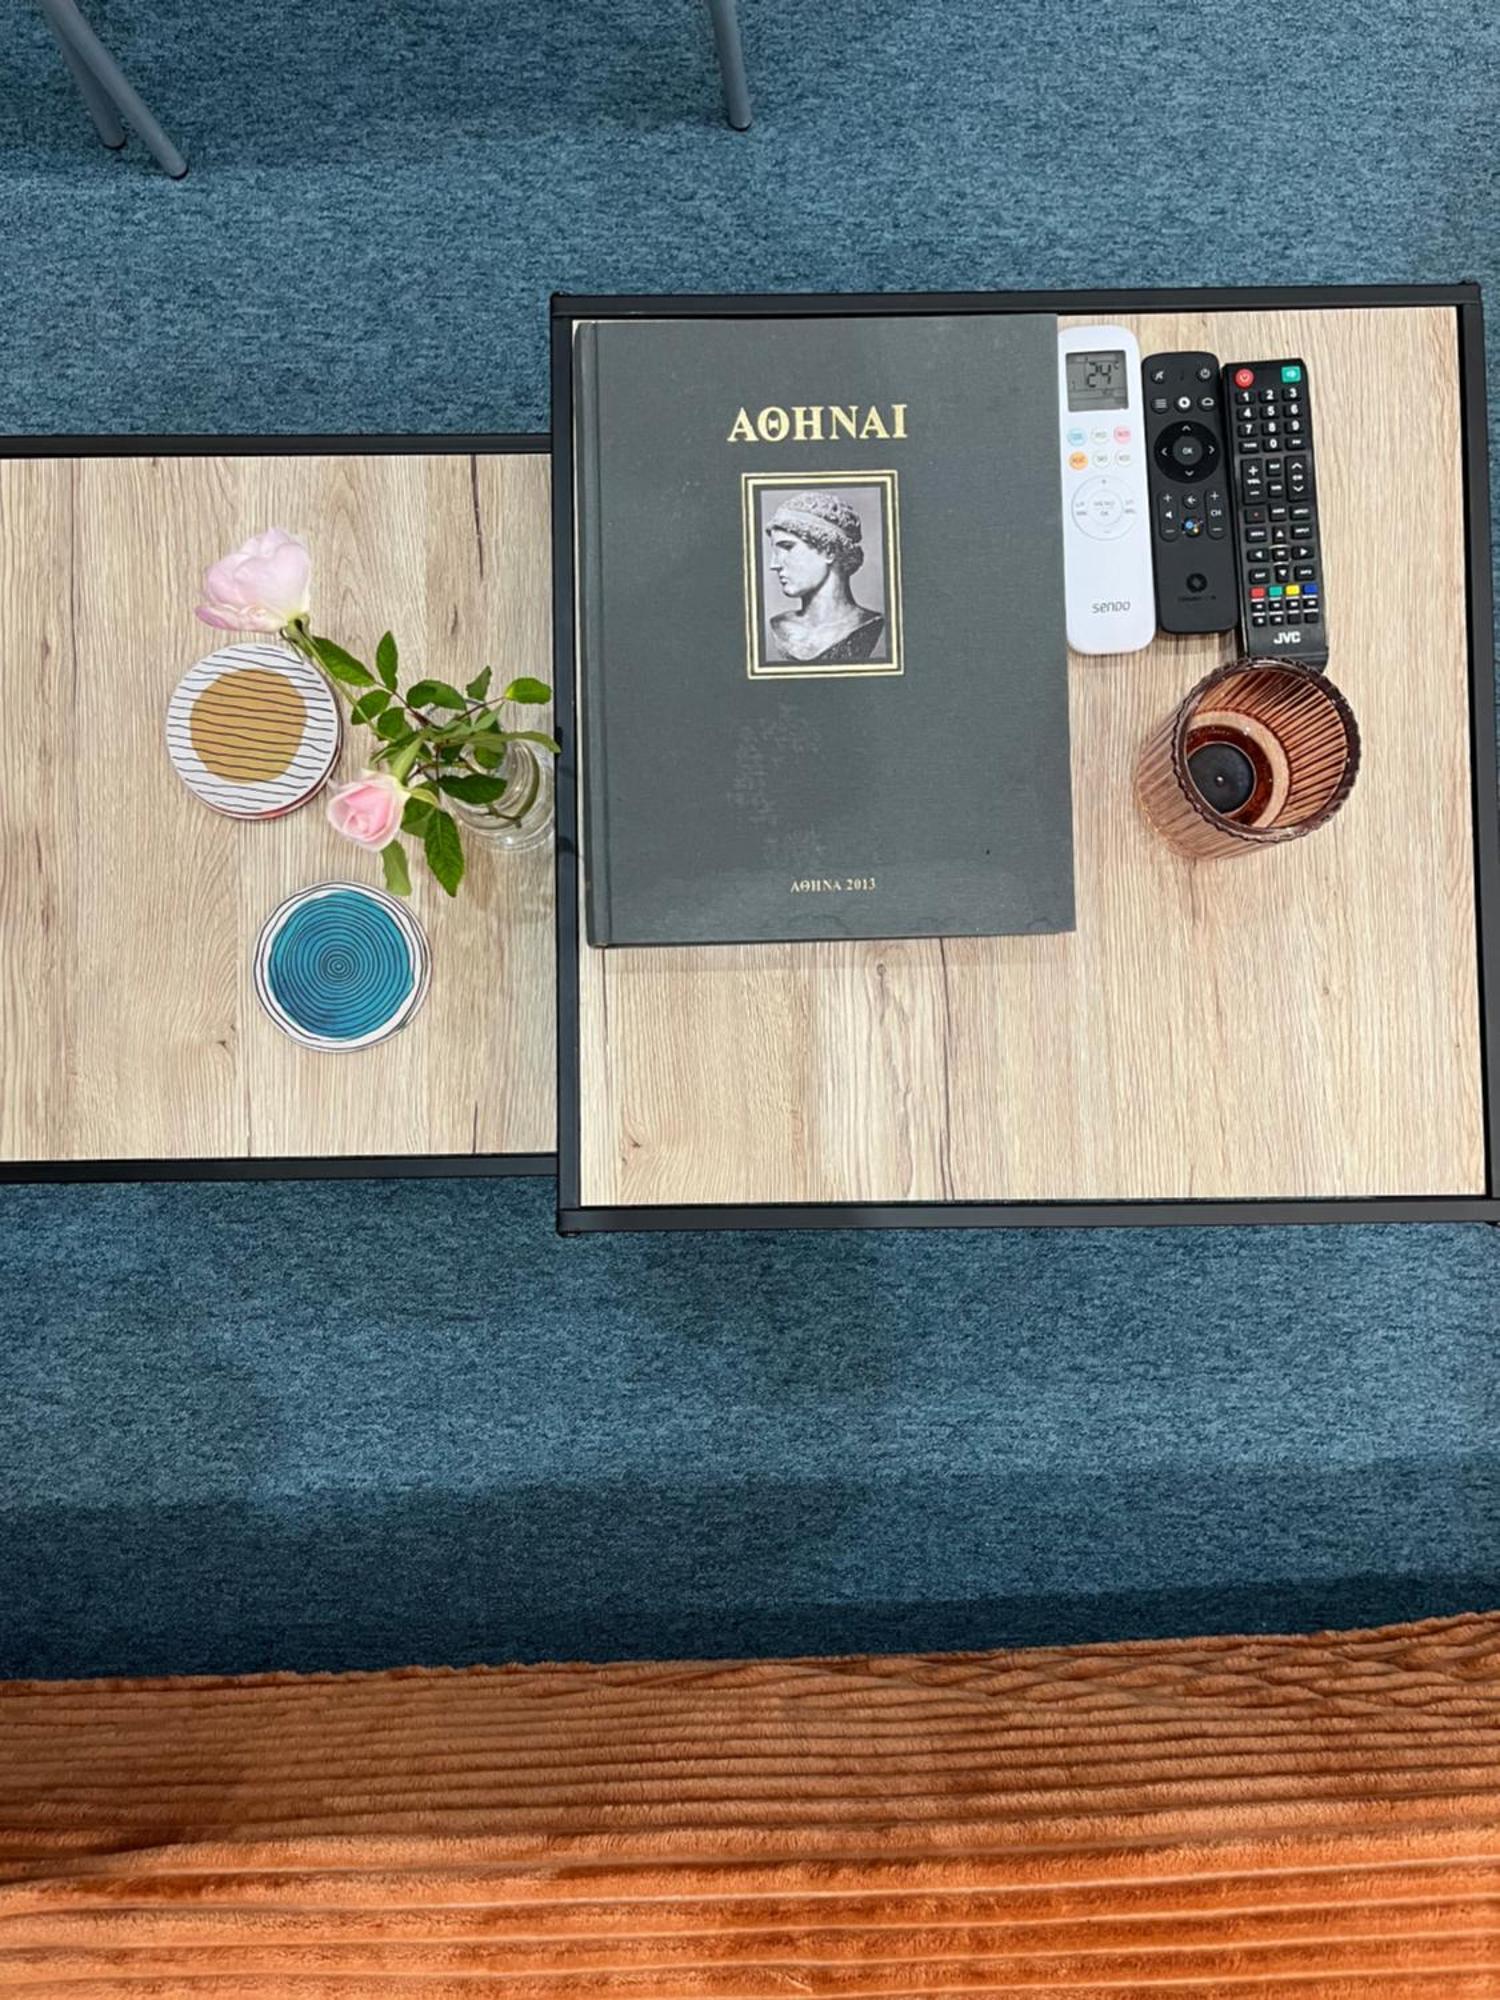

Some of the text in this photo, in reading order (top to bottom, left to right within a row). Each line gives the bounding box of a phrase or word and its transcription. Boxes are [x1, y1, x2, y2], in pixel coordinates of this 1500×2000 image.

[1243, 391, 1249, 402] 1
[1266, 389, 1274, 400] 2
[1289, 387, 1297, 398] 3
[1243, 407, 1252, 418] 4
[1267, 405, 1275, 416] 5
[1291, 404, 1299, 415] 6
[726, 404, 908, 442] ΑΘΗΝΑΙ
[1245, 423, 1253, 434] 7
[1268, 421, 1276, 432] 8
[1291, 420, 1300, 431] 9
[1269, 438, 1278, 448] 0
[1273, 631, 1301, 644] JVC
[790, 877, 876, 893] ΑΘΗΝΑ 2013
